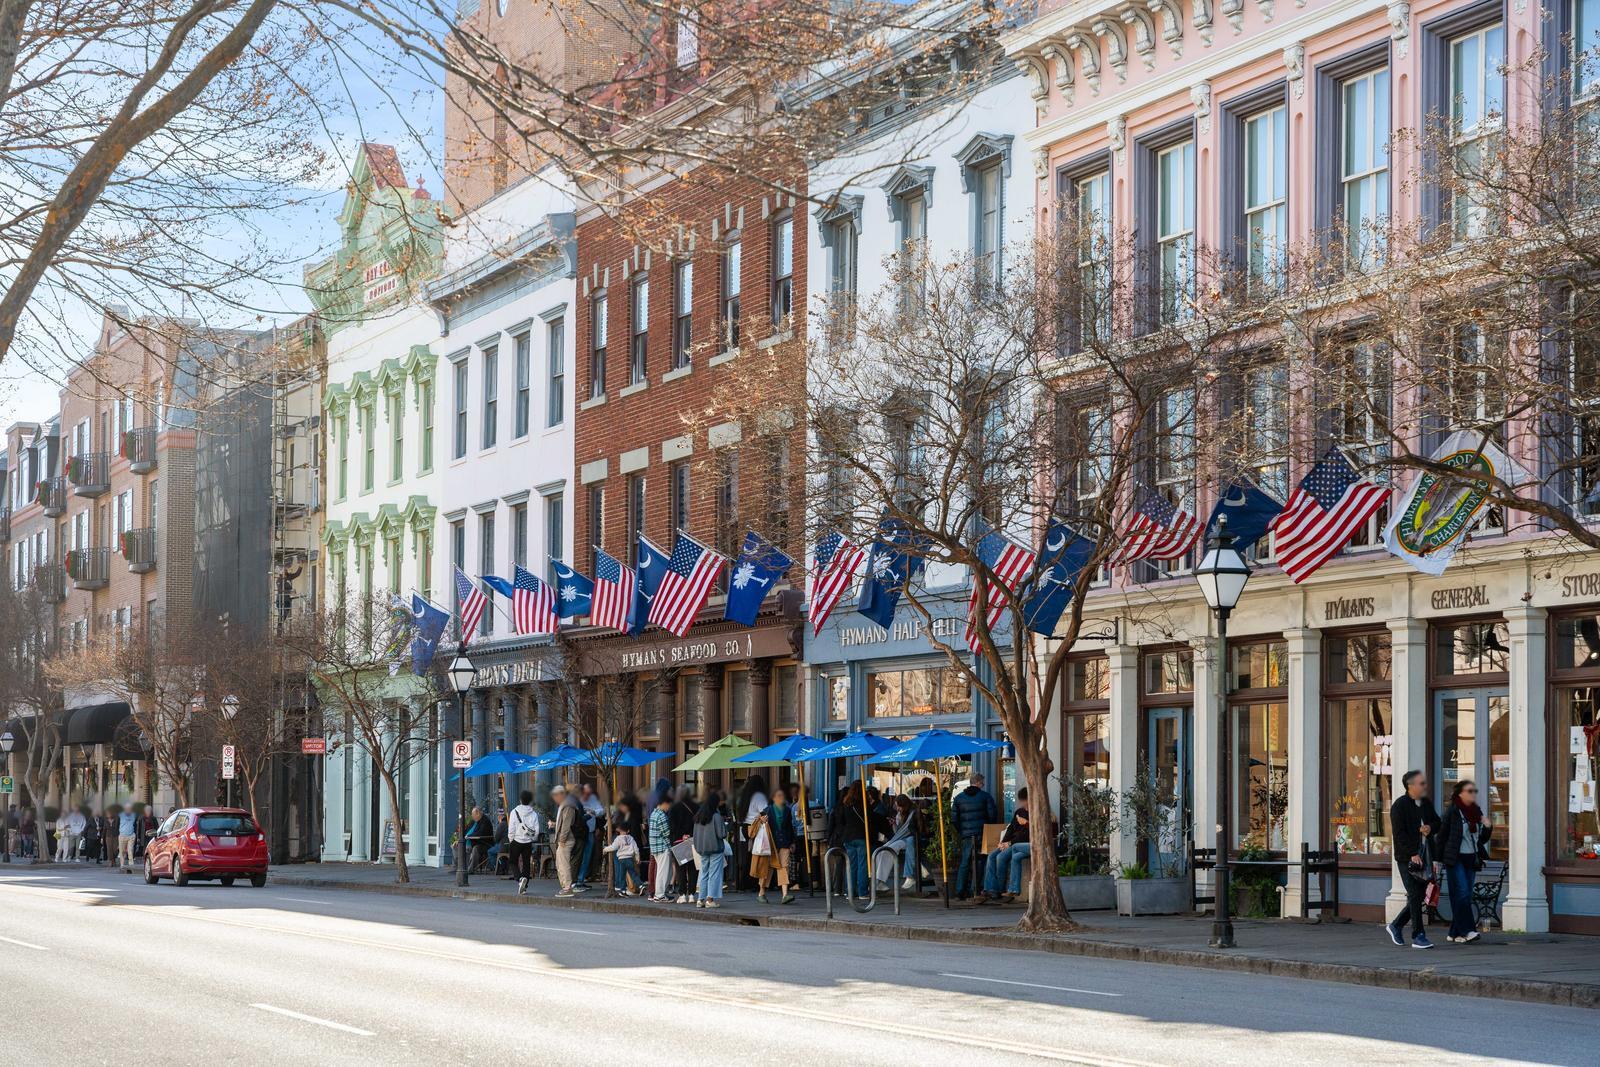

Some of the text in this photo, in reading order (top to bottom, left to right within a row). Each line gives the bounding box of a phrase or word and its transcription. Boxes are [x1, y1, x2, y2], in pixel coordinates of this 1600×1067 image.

[1430, 490, 1481, 547] CHARLESTON
[1431, 584, 1490, 610] GENERAL
[1562, 572, 1600, 598] STOR
[893, 619, 921, 641] HALF
[932, 618, 958, 637] HELL
[671, 642, 717, 662] SEAFOOD
[513, 659, 542, 683] DELI
